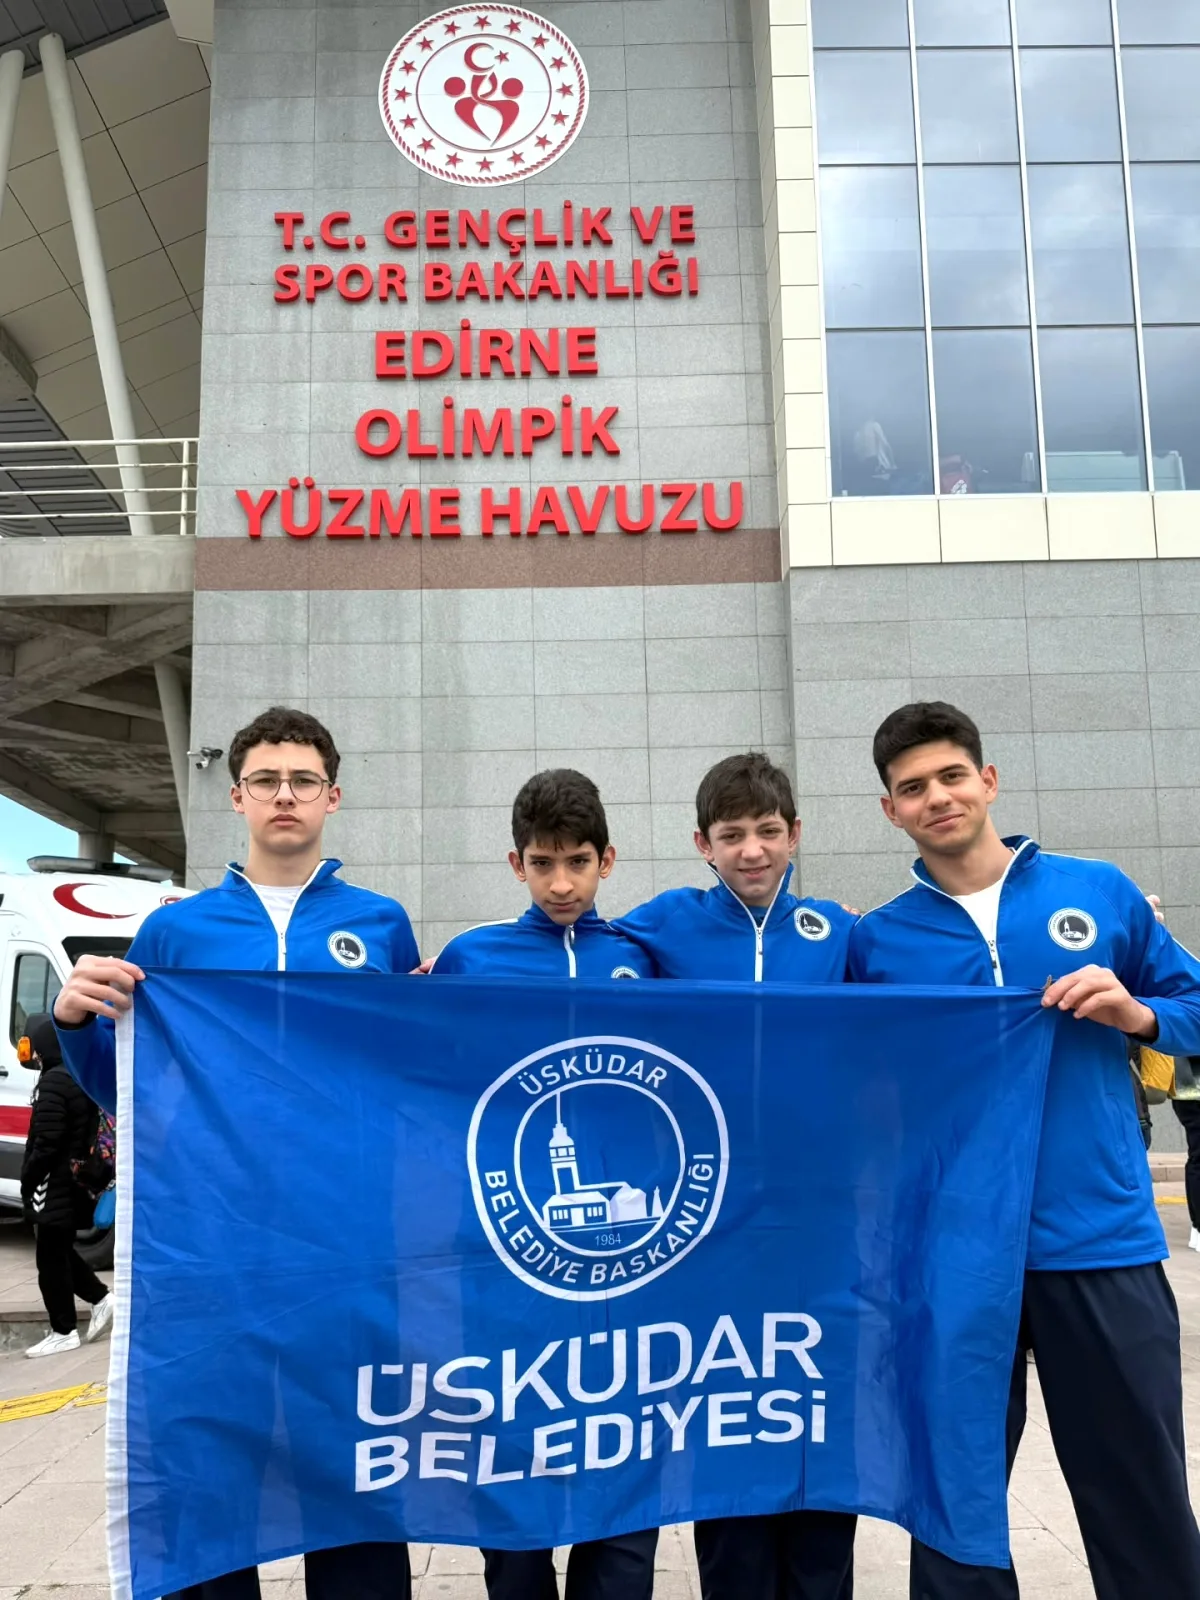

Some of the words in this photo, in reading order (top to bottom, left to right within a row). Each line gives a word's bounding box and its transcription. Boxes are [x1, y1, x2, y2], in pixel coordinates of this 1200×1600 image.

[274, 211, 366, 250] T.C.
[384, 199, 613, 254] GENÇLİK
[630, 205, 696, 242] VE
[274, 263, 407, 301] SPOR
[424, 250, 698, 301] BAKANLIĞI
[375, 319, 598, 378] EDİRNE
[355, 395, 620, 458] OLİMPİK
[236, 477, 460, 538] YÜZME
[480, 482, 743, 537] HAVUZU
[517, 1048, 667, 1095] ÜSKÜDAR
[485, 1170, 584, 1283] BELEDİYE
[590, 1153, 714, 1284] BAŞKANLIĞI
[594, 1233, 622, 1246] 1984
[357, 1312, 824, 1426] ÜSKÜDAR
[355, 1390, 826, 1493] BELEDİYESİ
